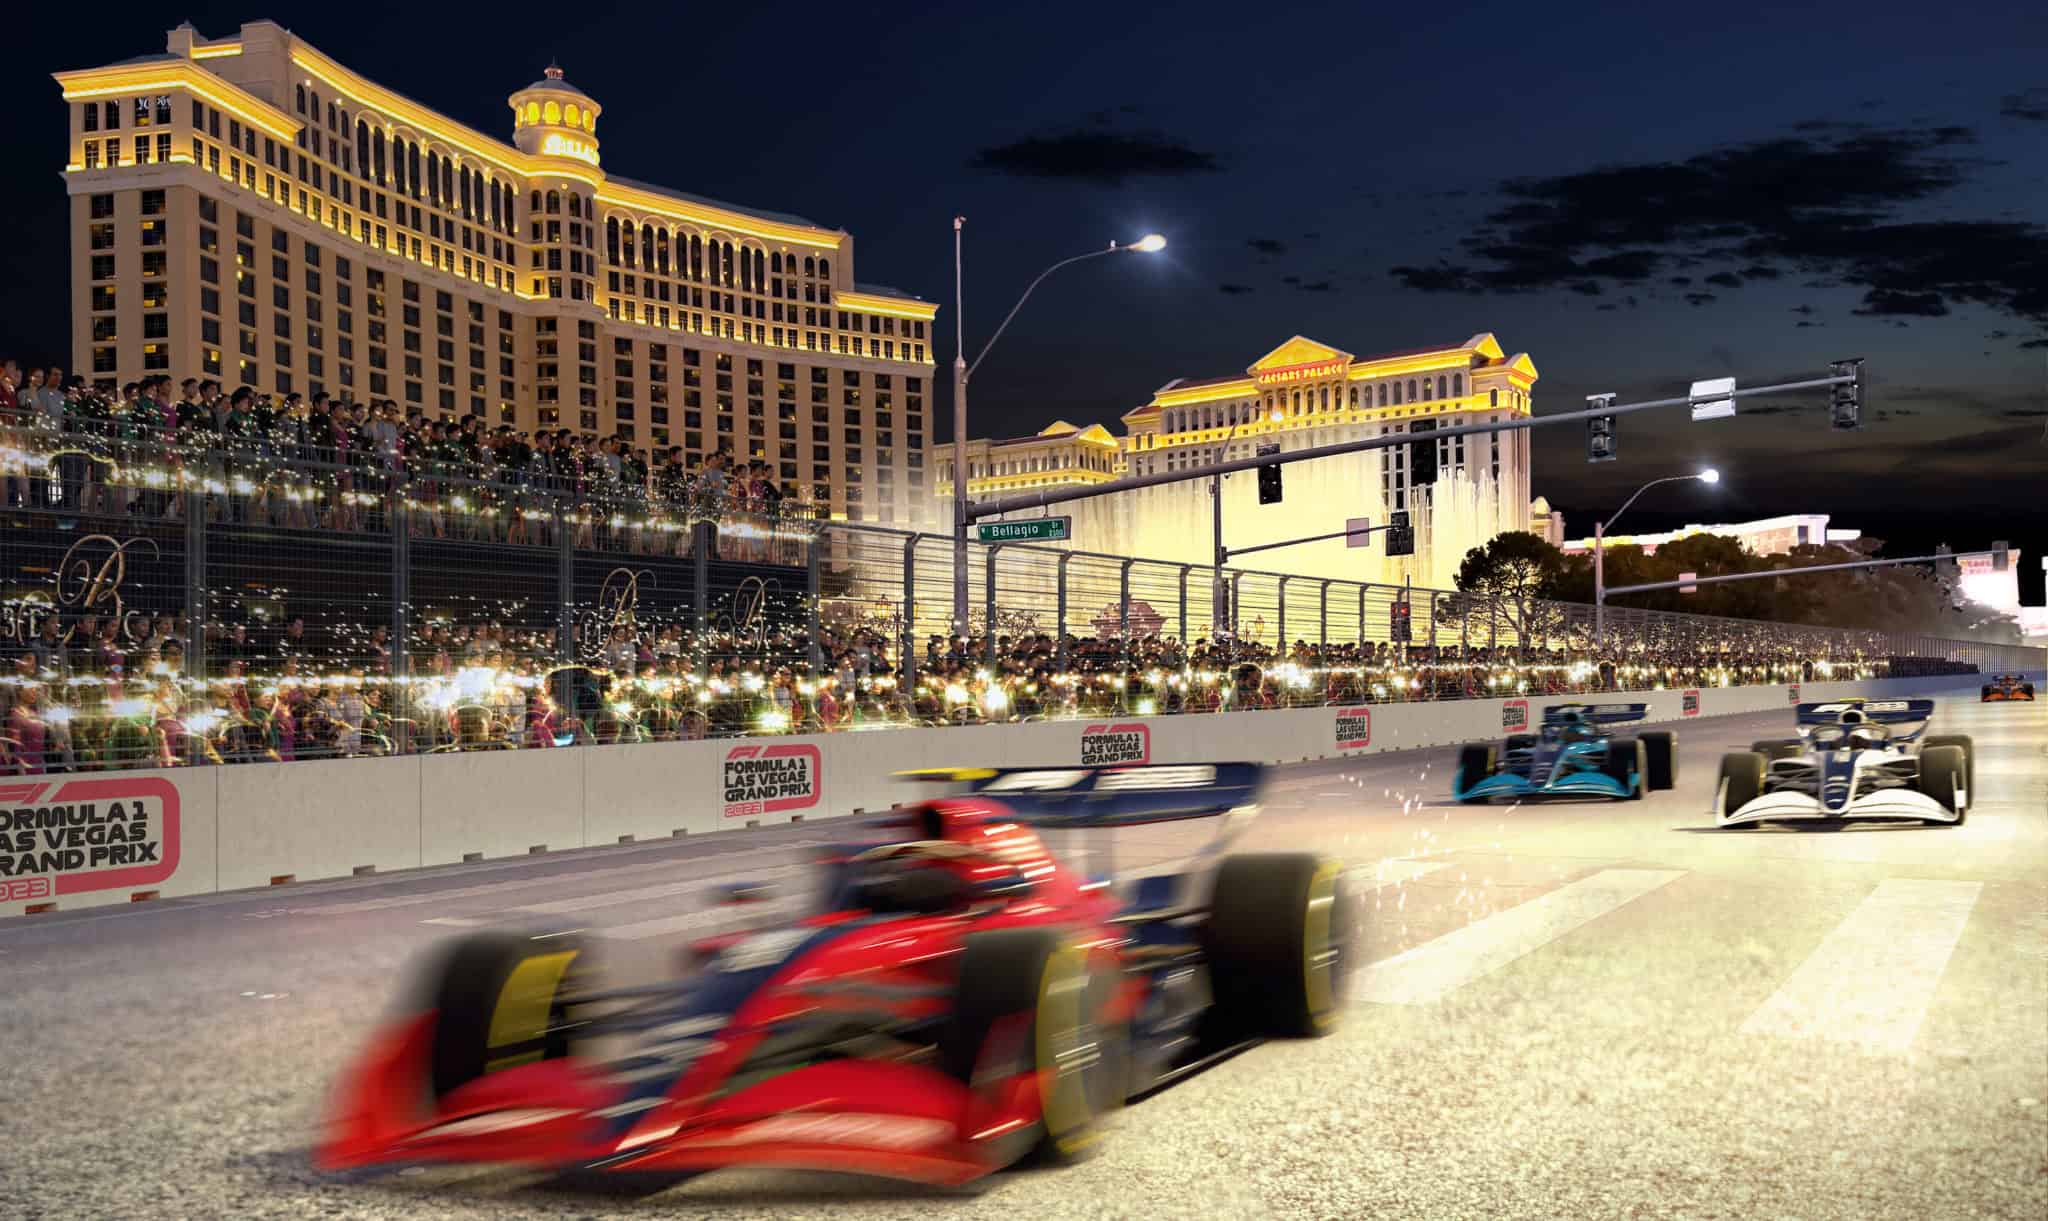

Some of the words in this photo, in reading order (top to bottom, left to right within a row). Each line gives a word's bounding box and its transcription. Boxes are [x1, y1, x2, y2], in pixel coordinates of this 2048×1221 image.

[1259, 371, 1299, 384] CAESARS
[1303, 364, 1342, 378] PALACE
[992, 524, 1039, 537] Bellagio
[1082, 734, 1133, 744] FORMULA
[1082, 744, 1104, 755] LAS
[1106, 742, 1139, 752] VEGAS
[1082, 753, 1119, 764] GRAND
[1120, 751, 1143, 760] PRIX
[725, 758, 797, 775] FORMULA
[799, 758, 807, 769] 1
[725, 774, 755, 788] LAS
[758, 770, 806, 785] VEGAS
[725, 786, 778, 802] GRAND
[780, 782, 811, 797] PRIX
[0, 802, 128, 831] ORMULA
[132, 801, 148, 821] 1
[0, 831, 36, 853] AS
[44, 822, 147, 850] VEGAS
[0, 850, 85, 876] RAND
[90, 841, 158, 867] PRIX
